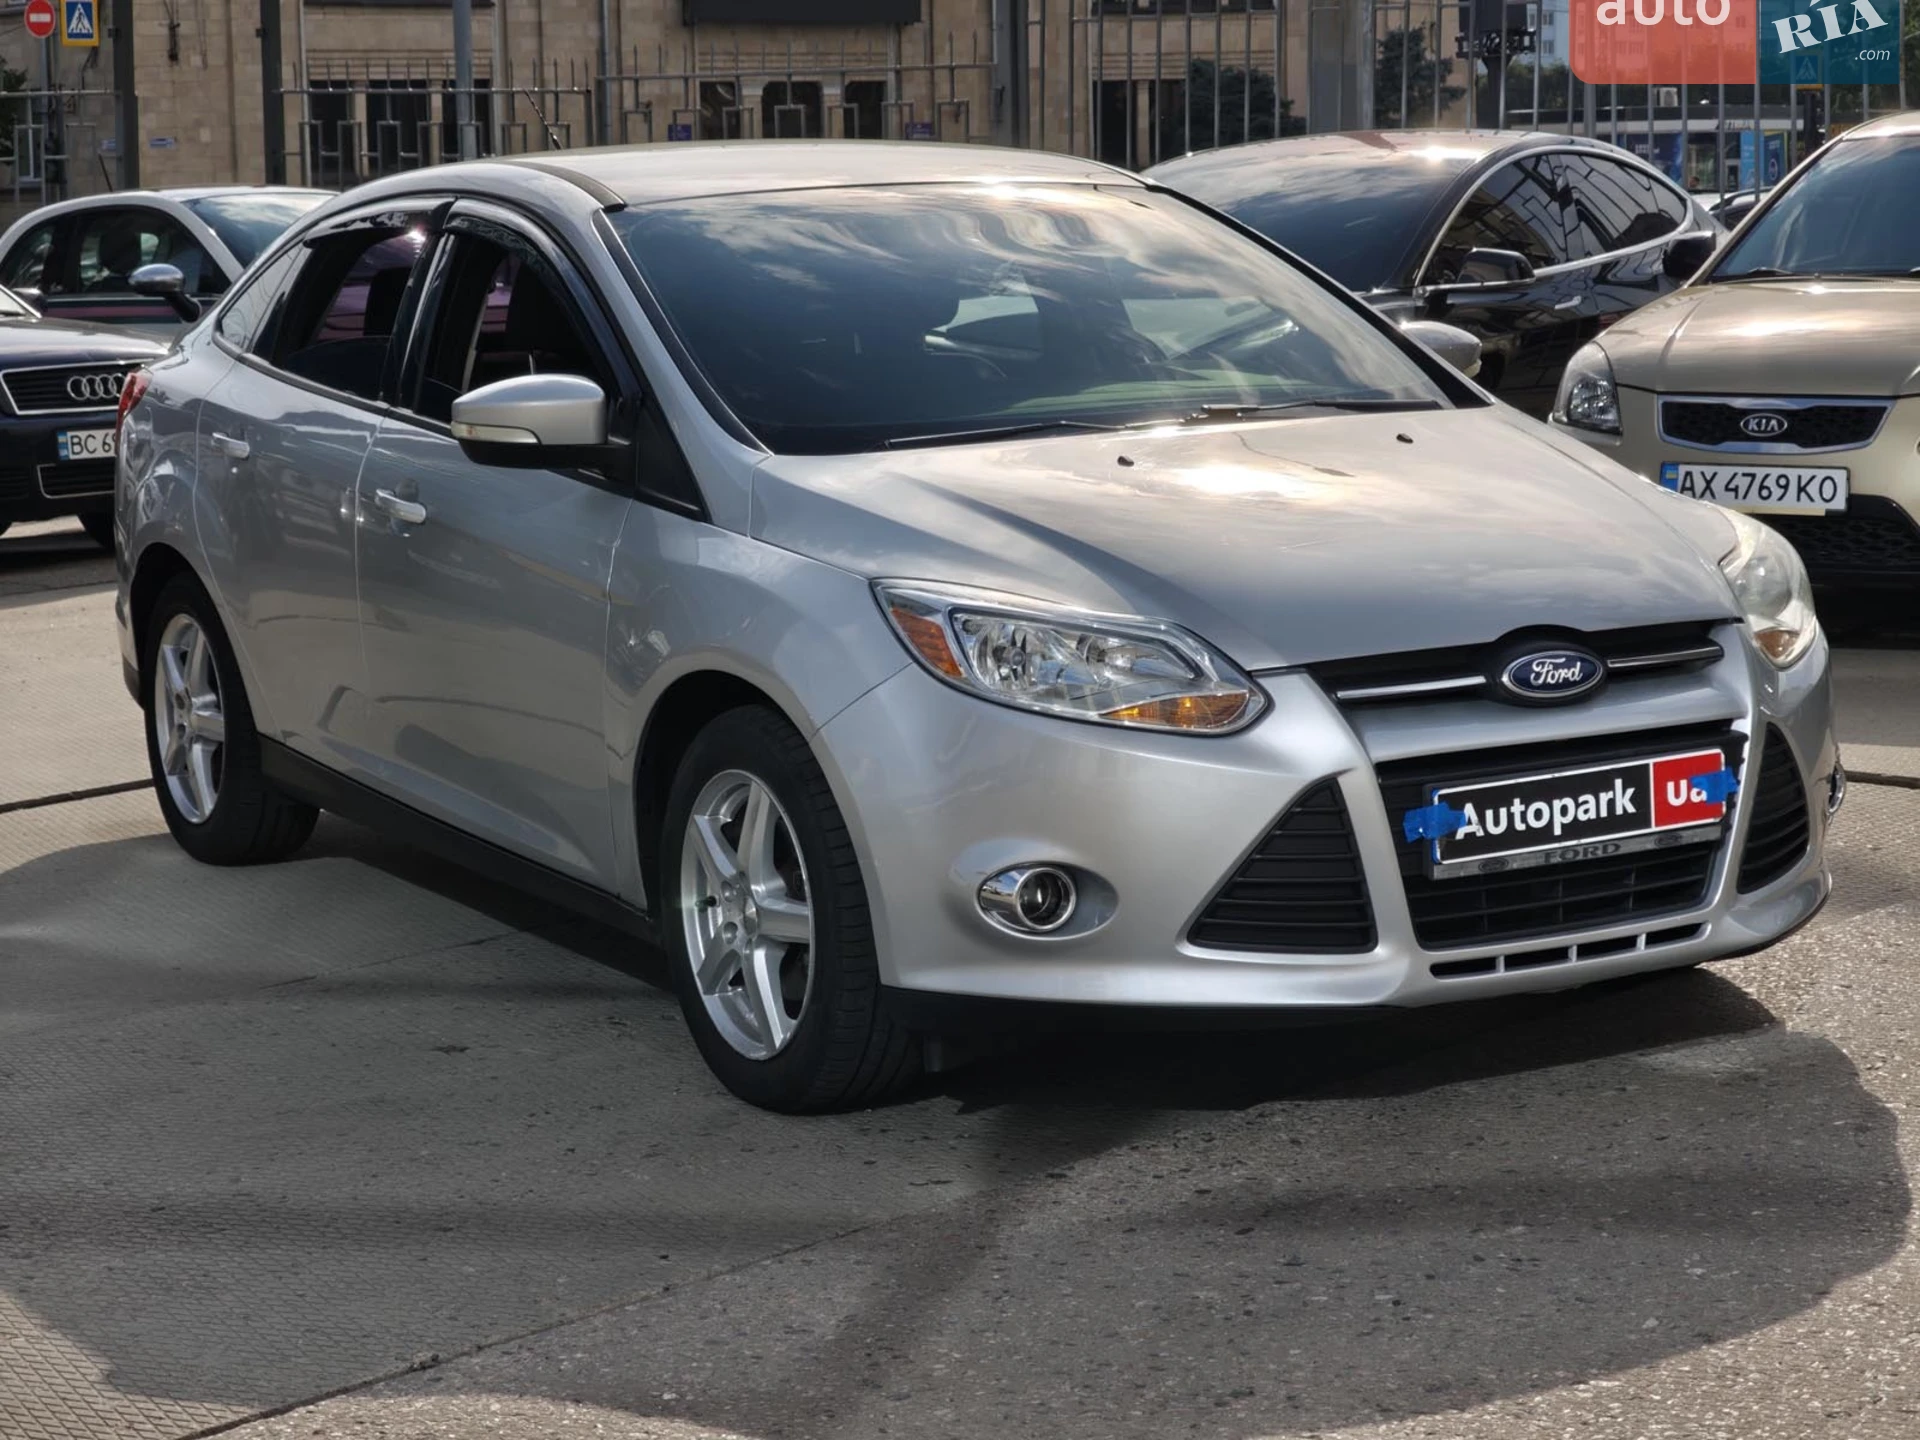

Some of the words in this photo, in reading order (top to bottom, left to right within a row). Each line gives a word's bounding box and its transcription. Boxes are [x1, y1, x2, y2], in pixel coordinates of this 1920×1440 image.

[1747, 417, 1779, 432] KIA
[1530, 657, 1583, 686] Ford
[1455, 778, 1636, 840] Autopark
[1543, 843, 1622, 865] FORD
